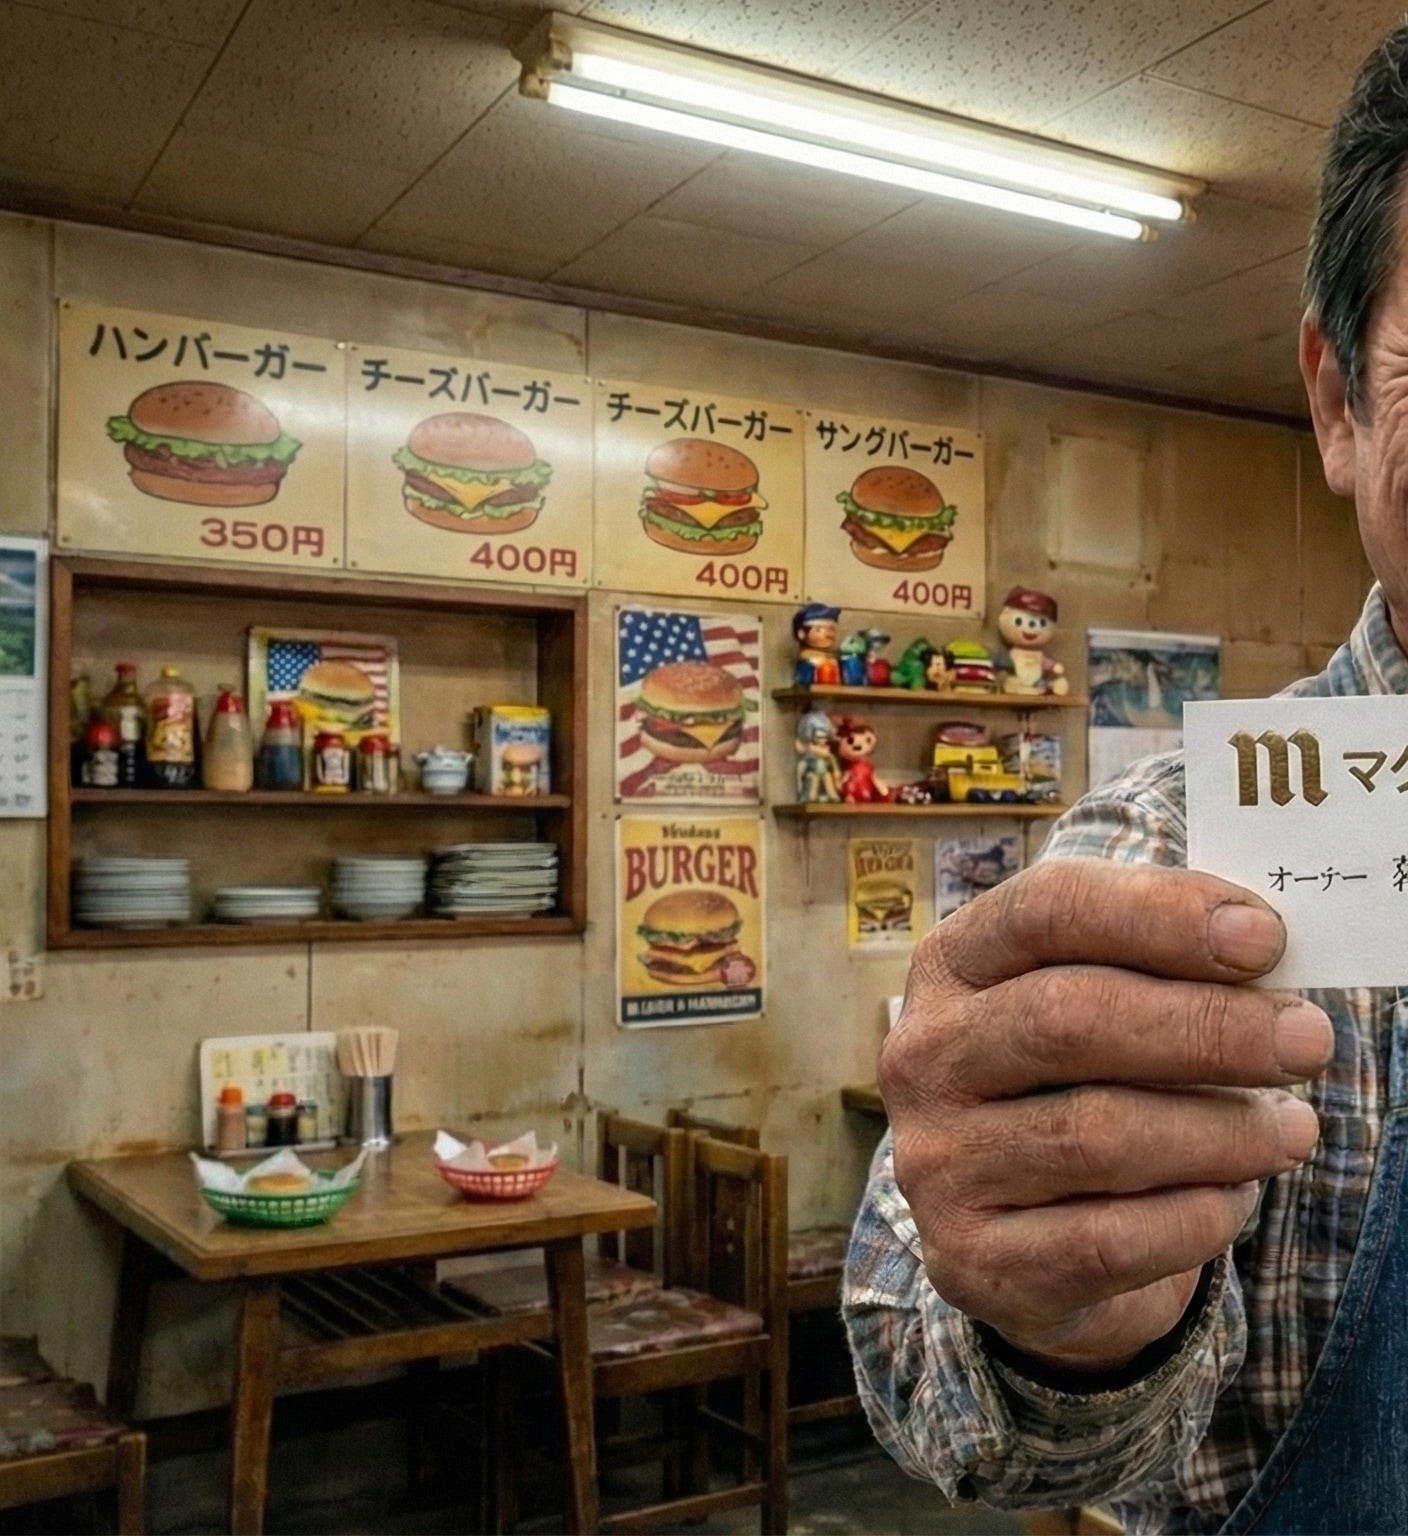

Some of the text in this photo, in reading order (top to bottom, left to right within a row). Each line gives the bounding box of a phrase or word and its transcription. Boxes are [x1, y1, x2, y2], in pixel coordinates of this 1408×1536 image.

[89, 323, 327, 380] ハンバーガー
[361, 359, 580, 413] チーズバーガー
[607, 393, 792, 441] チーズバーガー
[200, 518, 325, 556] 350円
[470, 542, 577, 578] 400円
[696, 562, 788, 595] 400円
[893, 580, 972, 610] 400円
[624, 843, 759, 901] BURGER
